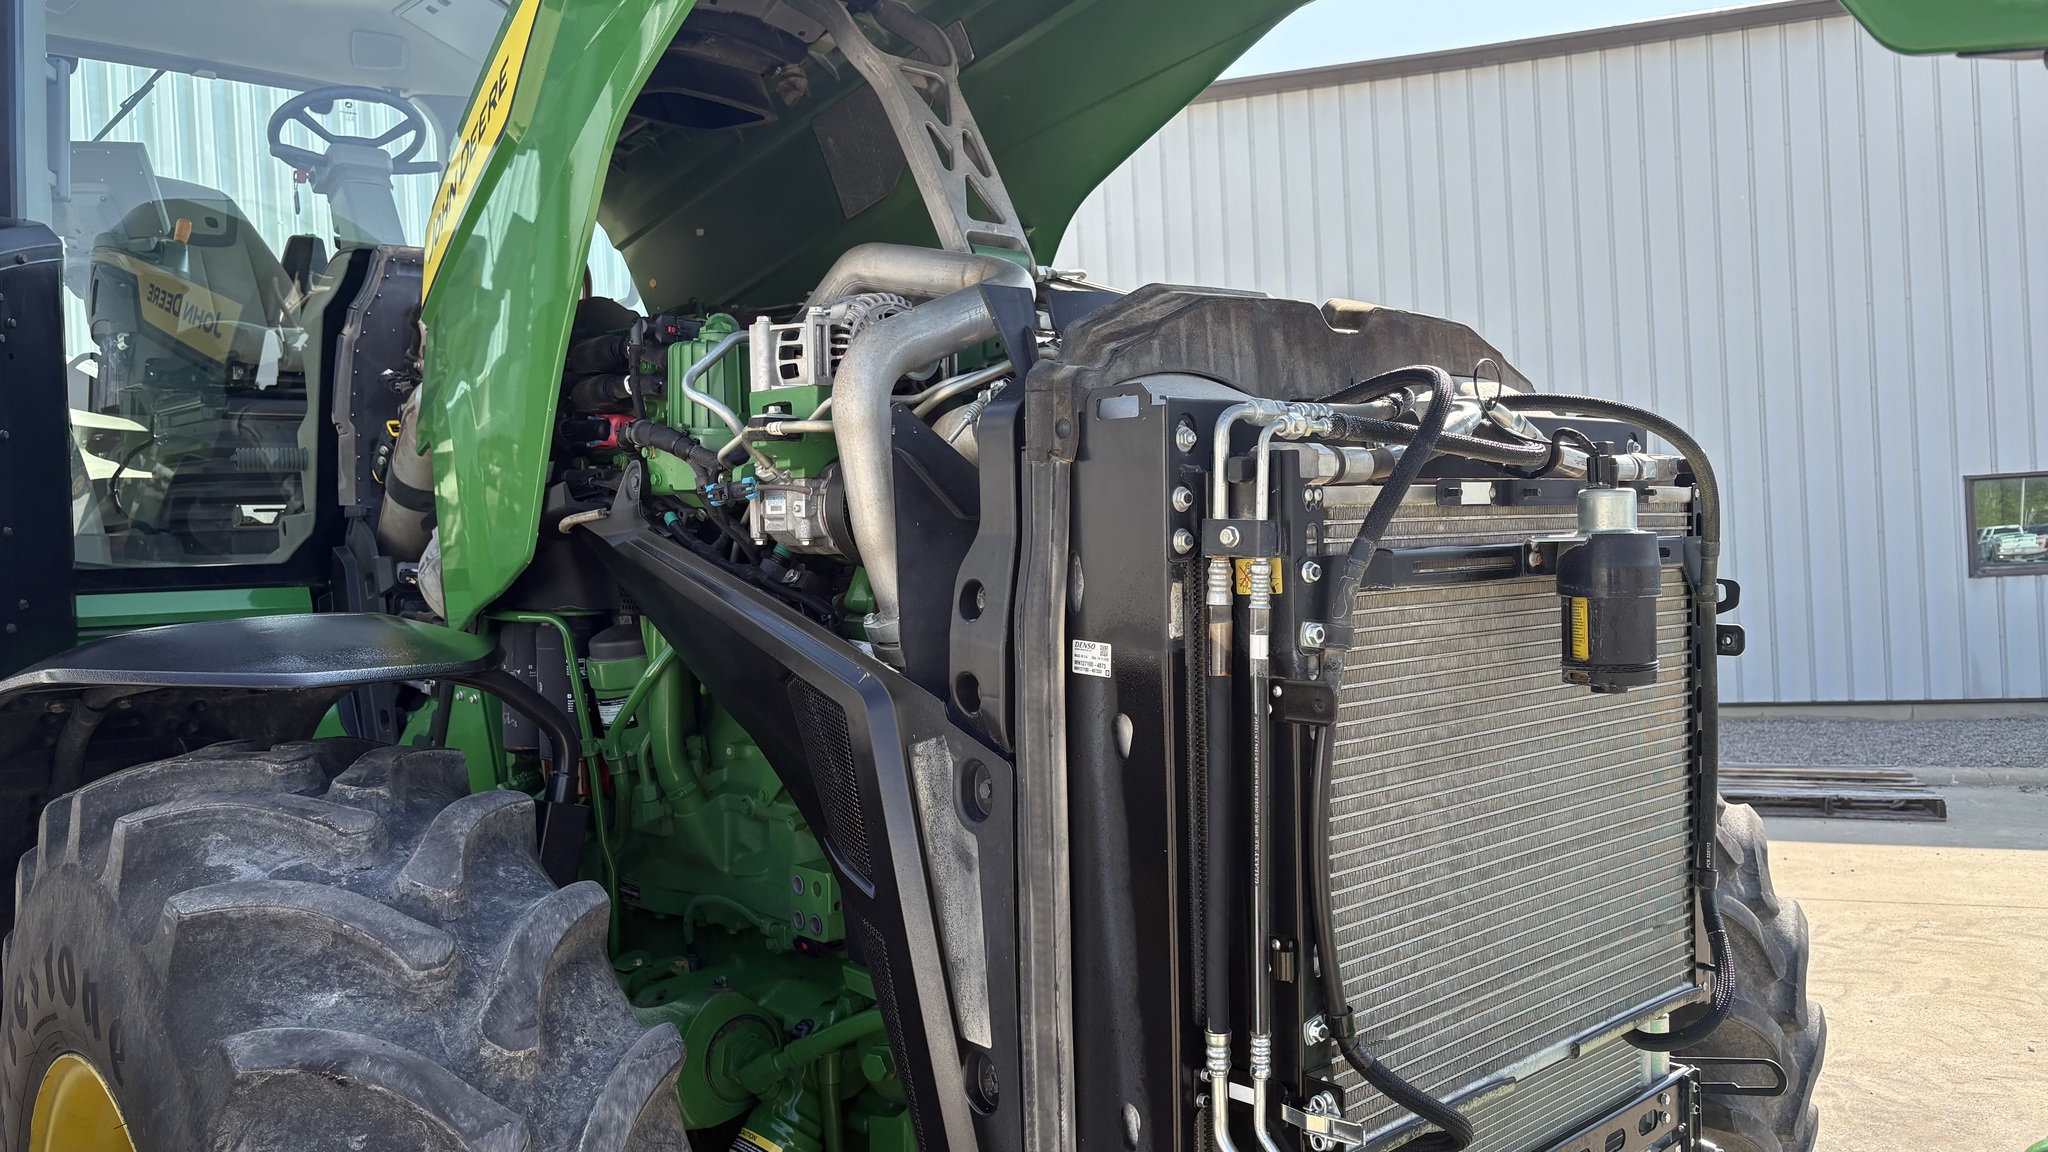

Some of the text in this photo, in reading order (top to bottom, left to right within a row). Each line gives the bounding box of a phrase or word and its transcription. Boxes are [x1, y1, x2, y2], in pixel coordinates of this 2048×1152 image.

[428, 54, 509, 265] JOHN DEERE
[1074, 641, 1096, 650] DENSO
